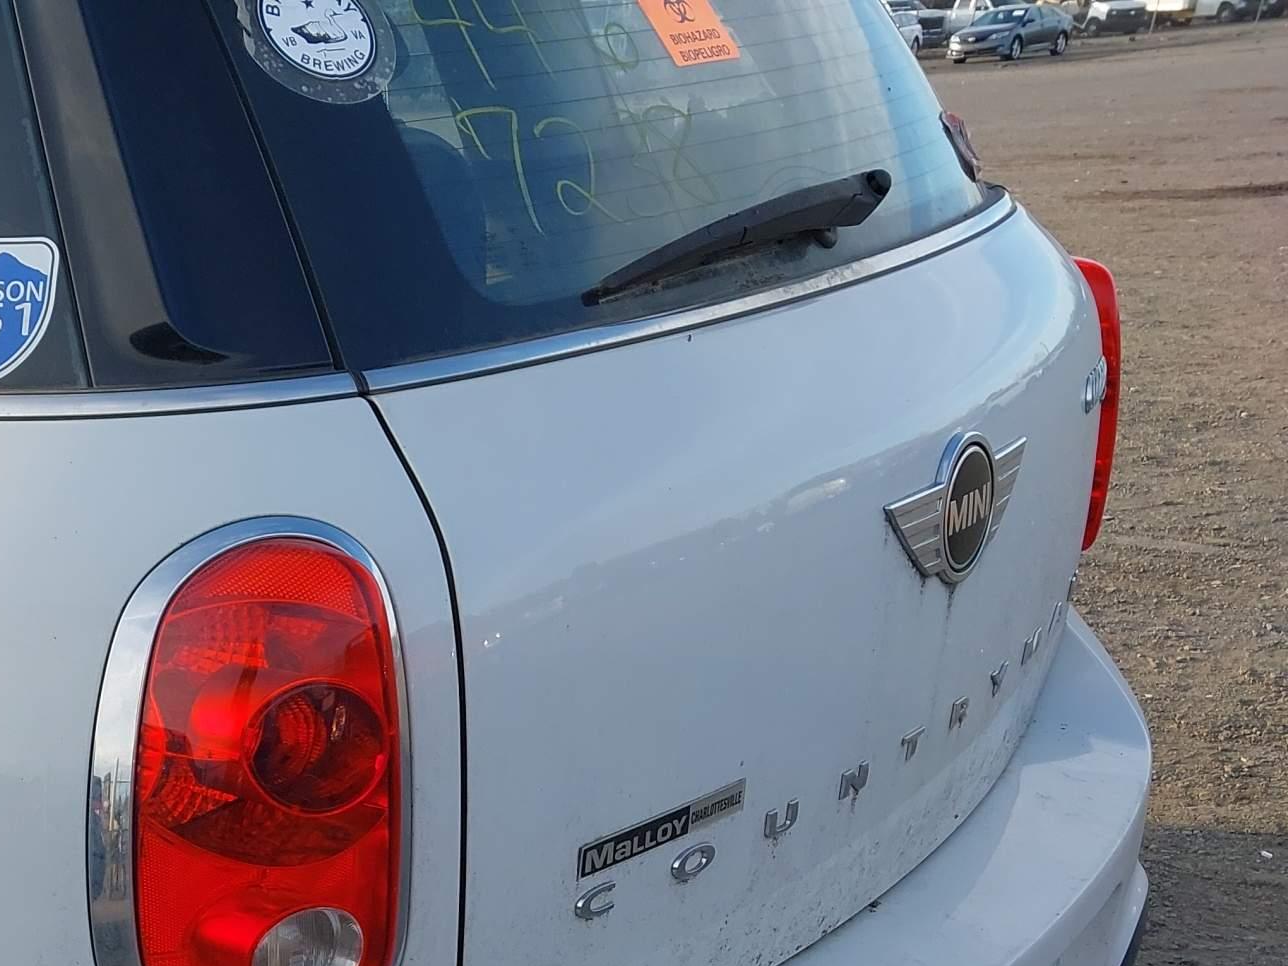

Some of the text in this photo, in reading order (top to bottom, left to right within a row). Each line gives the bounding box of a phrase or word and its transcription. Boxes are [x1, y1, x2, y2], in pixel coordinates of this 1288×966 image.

[281, 29, 366, 48] VB VA
[669, 28, 721, 45] BIOHAZARD
[300, 49, 366, 72] BREWING
[679, 44, 731, 62] BIOPELIGRO
[948, 480, 991, 537] MINI
[690, 790, 743, 825] CHARLOTTESVILLE
